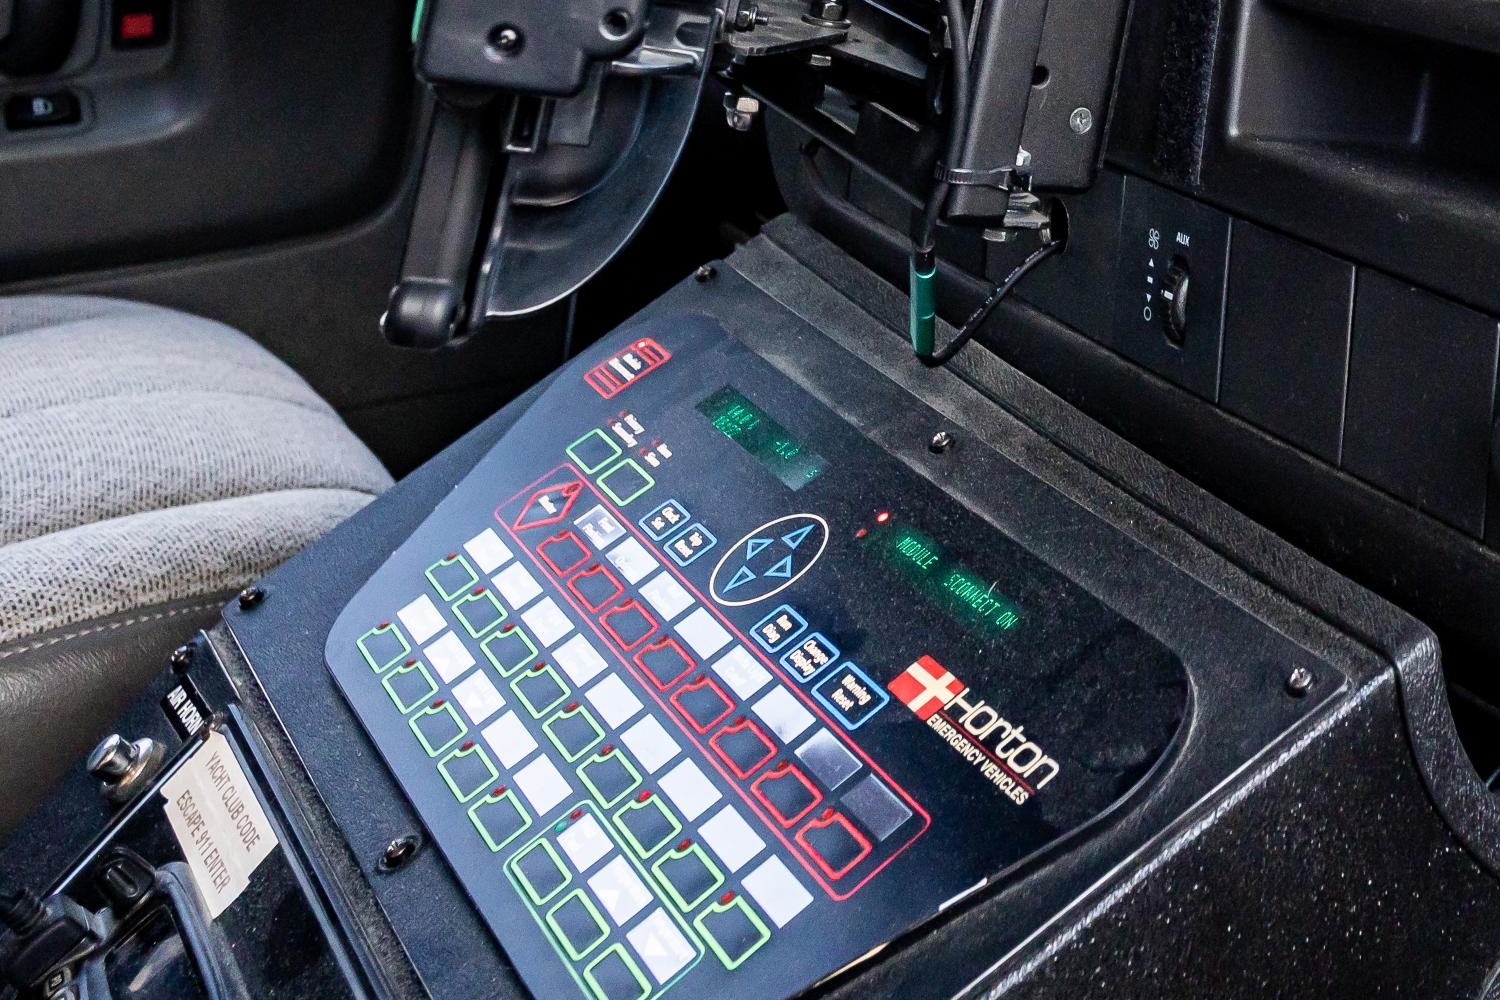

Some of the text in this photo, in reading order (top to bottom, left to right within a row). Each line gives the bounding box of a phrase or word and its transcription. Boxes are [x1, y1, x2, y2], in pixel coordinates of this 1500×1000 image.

[1176, 231, 1190, 247] AUX
[896, 536, 938, 569] MODULE
[995, 611, 1018, 630] ON
[776, 614, 793, 631] Run
[790, 649, 816, 677] Display
[803, 639, 829, 665] Change
[167, 685, 204, 736] AIR HORN
[831, 687, 854, 712] Reset
[841, 674, 871, 706] Warning
[943, 687, 1060, 790] Horton
[926, 713, 1029, 806] EMERGENCY VEHICLES
[205, 751, 260, 853] YACHT CLUB CODE
[176, 789, 231, 895] ESCAPE 911 ENTER
